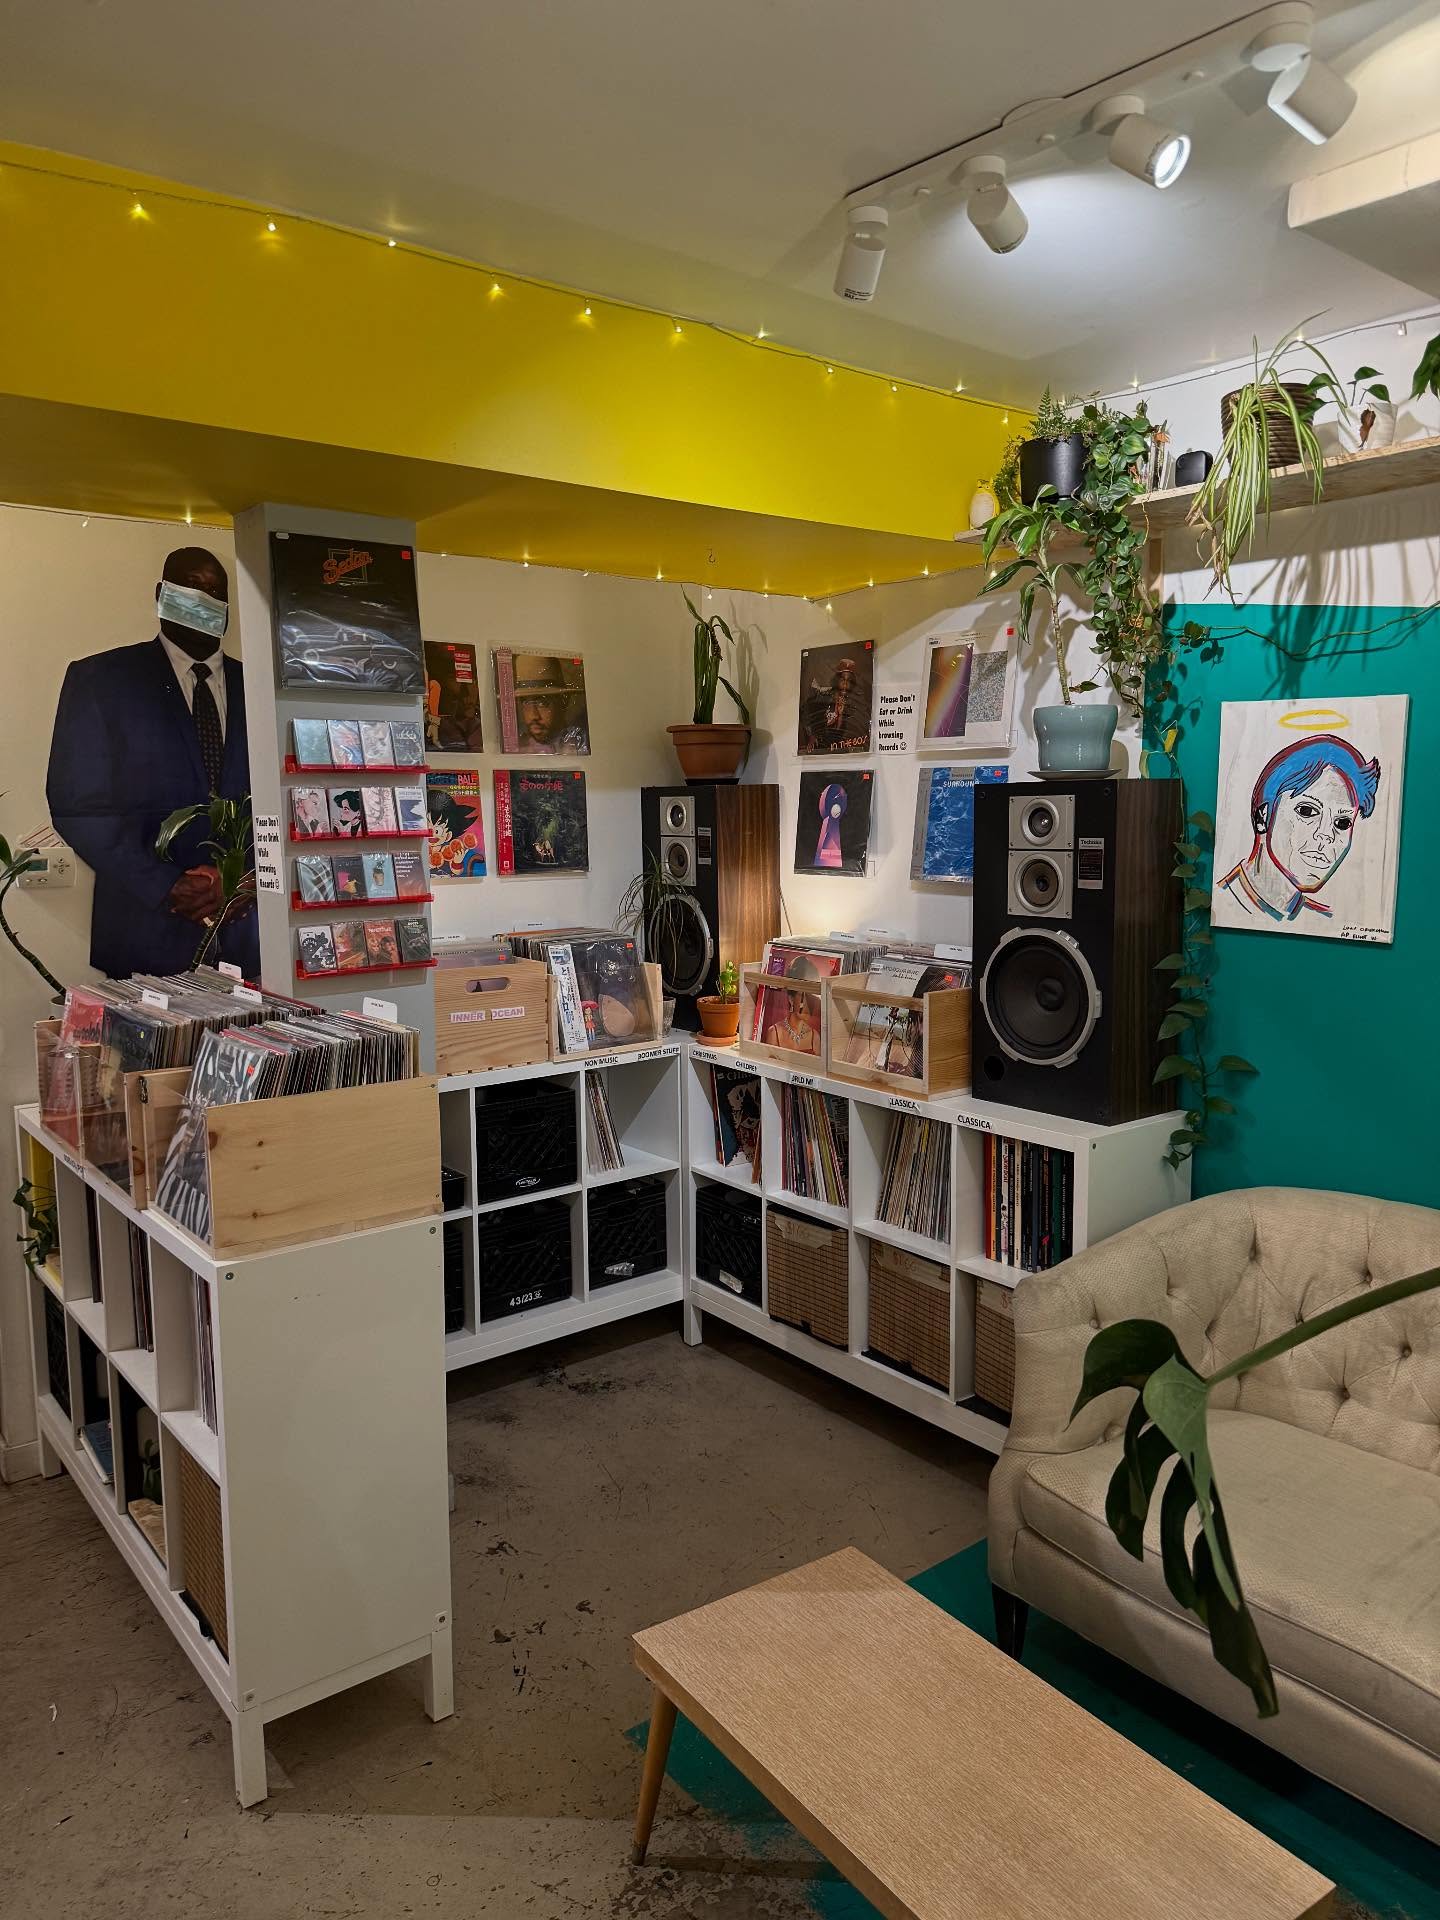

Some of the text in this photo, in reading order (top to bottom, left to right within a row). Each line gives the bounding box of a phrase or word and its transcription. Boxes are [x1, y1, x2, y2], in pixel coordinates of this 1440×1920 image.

[880, 694, 915, 703] Please Don't
[897, 706, 913, 714] Drink
[878, 719, 894, 727] While
[878, 731, 904, 739] browsing
[878, 743, 899, 751] Records
[452, 1012, 484, 1022] INNER
[637, 1047, 680, 1060] BOOMER STUFF
[584, 1056, 619, 1068] NON MUSIC
[890, 1098, 916, 1110] LASSICA
[957, 1114, 992, 1130] CLASSICA
